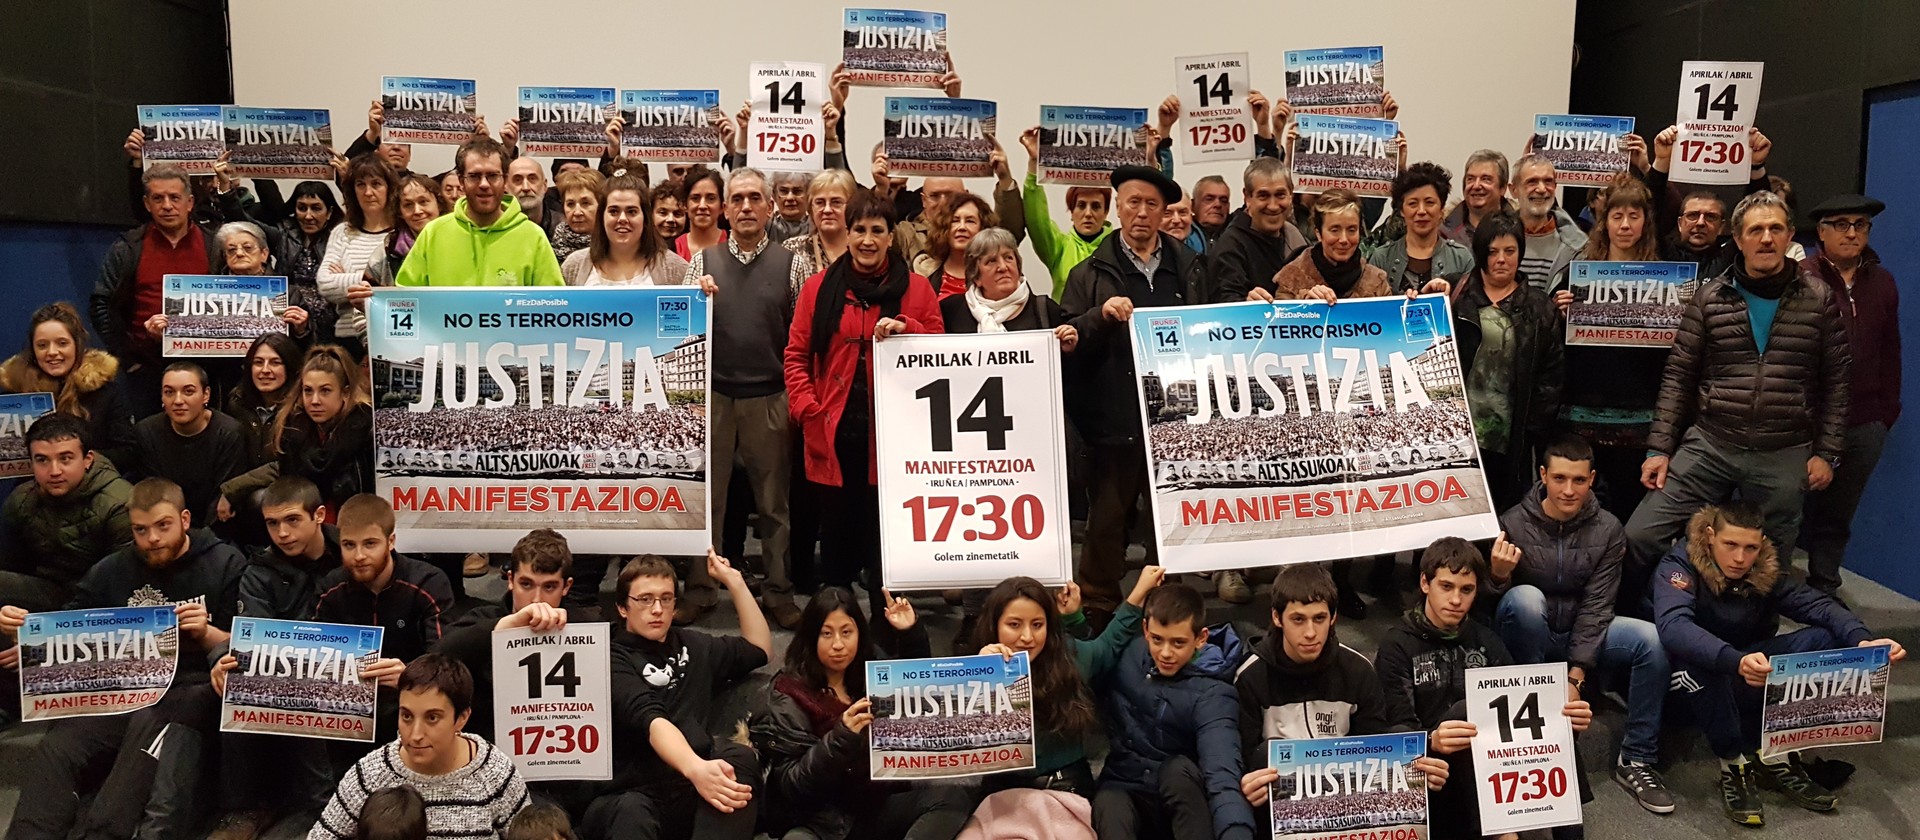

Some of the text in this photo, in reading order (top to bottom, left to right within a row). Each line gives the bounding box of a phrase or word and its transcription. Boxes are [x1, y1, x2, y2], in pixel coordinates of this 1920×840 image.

[885, 16, 925, 24] TERRORISMO
[855, 25, 937, 52] JUSTIZIA
[757, 69, 816, 78] APIRILAK ABRIL
[1184, 60, 1241, 71] APIRILAK ABRIL
[1297, 61, 1374, 87] JUSTIZIA
[849, 72, 940, 83] MANIFESTAZIOA
[1689, 70, 1753, 79] APIRILAK ABRIL
[764, 81, 806, 114] 14
[1193, 72, 1233, 107] 14
[393, 90, 466, 114] JUSTIZIA
[930, 104, 972, 112] TERRORISMO
[1694, 83, 1739, 121] 14
[530, 101, 606, 125] JUSTIZIA
[633, 104, 709, 128] JUSTIZIA
[757, 116, 814, 125] MANIFESTAZIOA
[1189, 108, 1242, 117] MANIFESTAZIOA
[237, 123, 321, 146] JUSTIZIA
[389, 130, 470, 140] MANIFESTAZIOA
[896, 114, 984, 140] JUSTIZIA
[1189, 123, 1246, 146] 17:30
[1337, 123, 1377, 132] TERRORISMO
[1685, 122, 1744, 133] MANIFESTAZIOA
[755, 132, 816, 154] 17:30
[1052, 123, 1137, 150] JUSTIZIA
[1305, 131, 1387, 159] JUSTIZIA
[1542, 129, 1619, 154] JUSTIZIA
[628, 148, 714, 158] MANIFESTAZIOA
[1680, 140, 1745, 165] 17:30
[235, 166, 328, 176] MANIFESTAZIOA
[890, 161, 986, 172] MANIFESTAZIOA
[1298, 177, 1388, 191] MANIFESTAZIOA
[1583, 279, 1680, 307] JUSTIZIA
[178, 292, 275, 318] JUSTIZIA
[389, 300, 415, 308] IRUÑEA
[660, 301, 688, 311] 17:30
[391, 314, 413, 330] 14
[444, 312, 634, 328] NO ES TERRORISMO
[1156, 330, 1178, 347] 14
[1208, 321, 1382, 342] NO ES TERRORISMO
[1575, 329, 1674, 340] MANIFESTAZIO
[896, 351, 973, 368] APIRILAK
[986, 350, 1034, 365] ABRIL
[408, 337, 670, 413] JUSTIZIA
[1186, 347, 1432, 425] JUSTIZIA
[915, 376, 1014, 452] 14
[474, 452, 581, 474] ALTSASUKOAK
[904, 458, 1036, 475] MANIFESTAZIOA
[1257, 457, 1357, 481] ALTSASUKOAK
[930, 478, 964, 488] IRUÑEA
[969, 478, 1015, 487] PAMPLONA
[392, 485, 687, 513] MANIFESTAZIOA
[1180, 475, 1468, 527] MANIFESTAZIOA
[902, 494, 1045, 542] 17:30
[934, 551, 1020, 562] Golem zinemetatik
[30, 624, 41, 632] 14
[56, 616, 145, 629] NO ES TERRORISMO
[241, 628, 252, 637] 14
[264, 630, 278, 639] NO
[280, 631, 291, 640] ES
[293, 632, 349, 644] TERRORISMO
[40, 628, 162, 667] JUSTIZIA
[506, 635, 556, 649] APIRILAK
[564, 635, 596, 645] ABRIL
[243, 643, 360, 685] JUSTIZIA
[1820, 656, 1865, 667] TERRORISMO
[518, 651, 582, 699] 14
[877, 673, 889, 682] 14
[902, 666, 995, 680] NO ES TERRORISMO
[1477, 677, 1521, 689] APIRILAK
[1528, 675, 1556, 685] ABRIL
[1778, 667, 1872, 706] JUSTIZIA
[34, 691, 158, 711] MANIFESTAZIOA
[510, 702, 595, 715] MANIFESTAZIOA
[889, 680, 1014, 720] JUSTIZIA
[233, 709, 364, 732] MANIFESTAZIOA
[1315, 711, 1333, 725] ongi
[1489, 692, 1546, 743] 14
[508, 724, 600, 756] 17:30
[921, 737, 973, 748] ALTSASUKOAK
[1770, 724, 1873, 747] MANIFESTAZIOA
[883, 747, 1024, 769] MANIFESTAZIOA
[1279, 751, 1291, 760] 14
[1305, 745, 1393, 758] NO ES TERRORISMO
[1487, 743, 1561, 759] MANIFESTAZIOA
[1290, 757, 1409, 801] JUSTIZIA
[1488, 766, 1567, 804] 17:30
[1524, 804, 1554, 814] zinemetatik
[1322, 815, 1371, 829] ALTSASUKOAK
